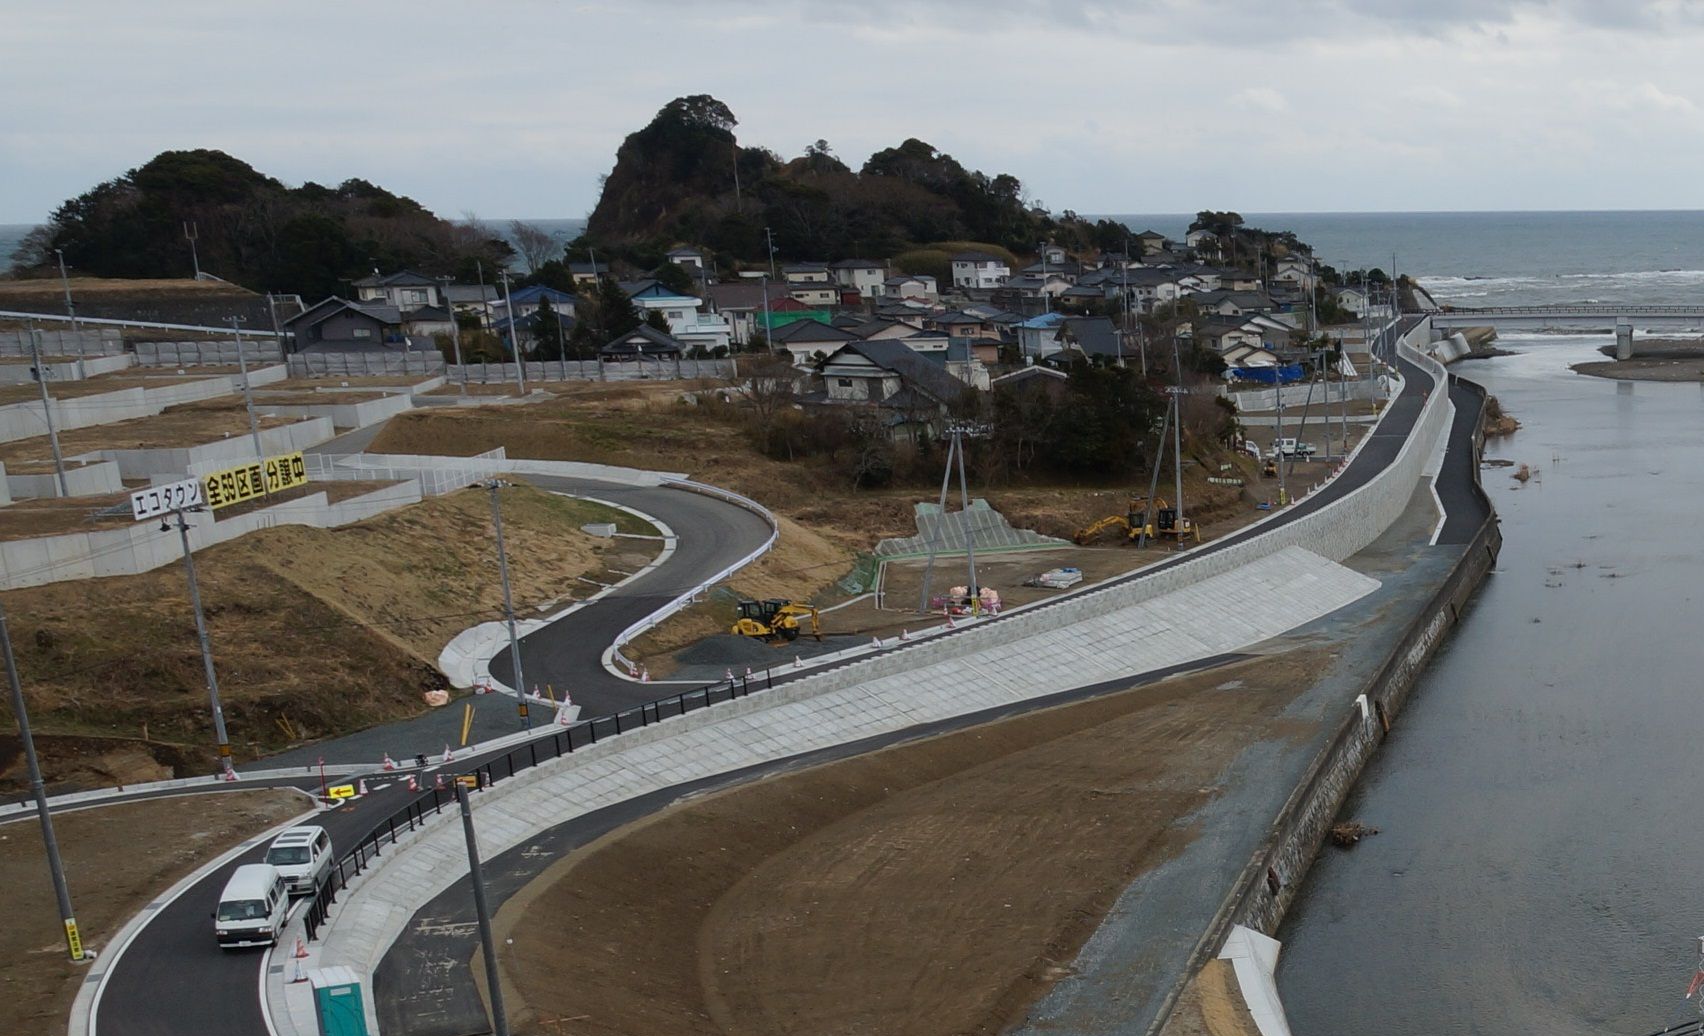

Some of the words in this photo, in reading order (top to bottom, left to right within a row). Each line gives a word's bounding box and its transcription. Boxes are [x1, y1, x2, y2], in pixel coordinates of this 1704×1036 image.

[136, 484, 197, 514] エコタウン
